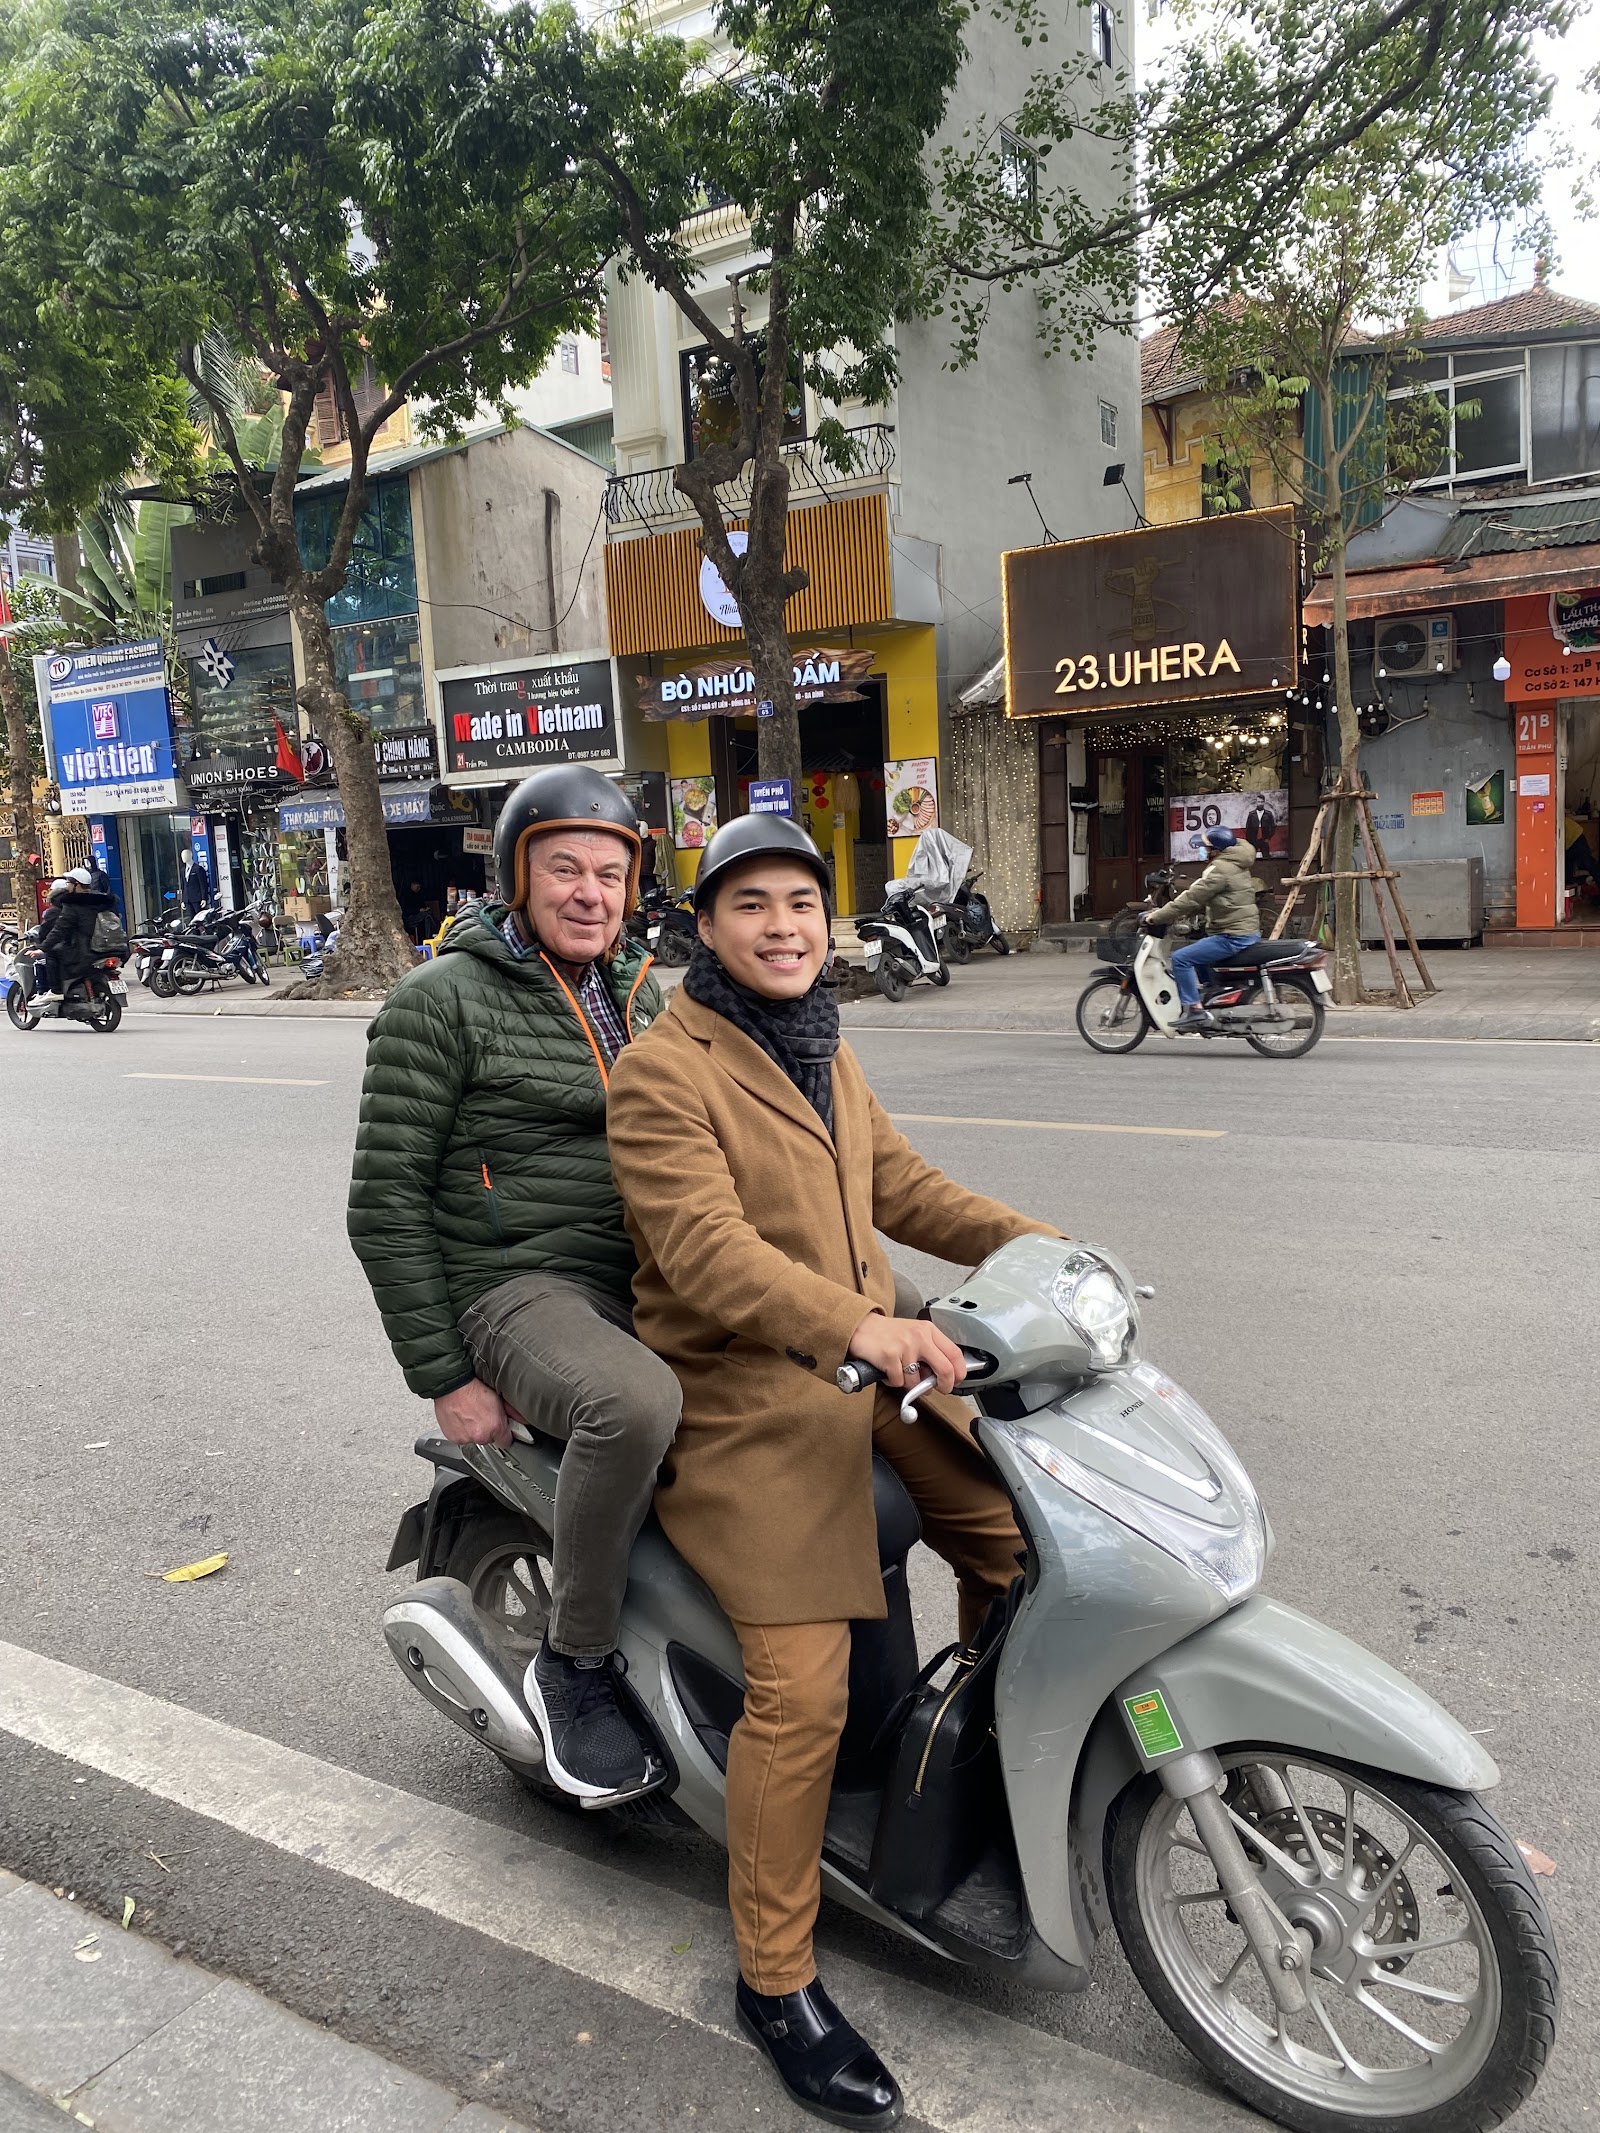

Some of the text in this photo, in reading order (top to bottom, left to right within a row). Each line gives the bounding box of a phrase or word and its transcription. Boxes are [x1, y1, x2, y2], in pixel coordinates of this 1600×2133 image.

[1054, 638, 1242, 694] 23.UHERA
[1524, 668, 1541, 678] Cơ
[1543, 664, 1558, 676] Sở
[1561, 664, 1569, 675] 1:
[474, 667, 579, 700] Thời trang xuất khẩu
[547, 689, 559, 699] hiệu
[560, 688, 574, 697] Quốc
[574, 686, 580, 696] tế
[661, 673, 693, 702] BÒ
[697, 667, 756, 698] NHÚN
[1525, 683, 1542, 692] Cơ
[1543, 679, 1558, 690] Sở
[1559, 680, 1570, 689] 2:
[1574, 677, 1593, 688] 147
[453, 703, 604, 742] Made in Vietnam
[1519, 714, 1550, 741] 21B
[382, 736, 430, 762] CHÍNH HÀNG
[496, 738, 570, 757] CAMBODIA
[61, 742, 157, 782] viettien
[456, 754, 488, 769] 21 Trần Phú
[190, 765, 279, 786] UNION SHOES
[771, 784, 784, 796] PHỐ
[390, 798, 426, 817] XE MÁY
[1146, 797, 1164, 807] VINTA
[283, 804, 339, 825] THAY DẦU RỬA
[1186, 804, 1221, 831] 50
